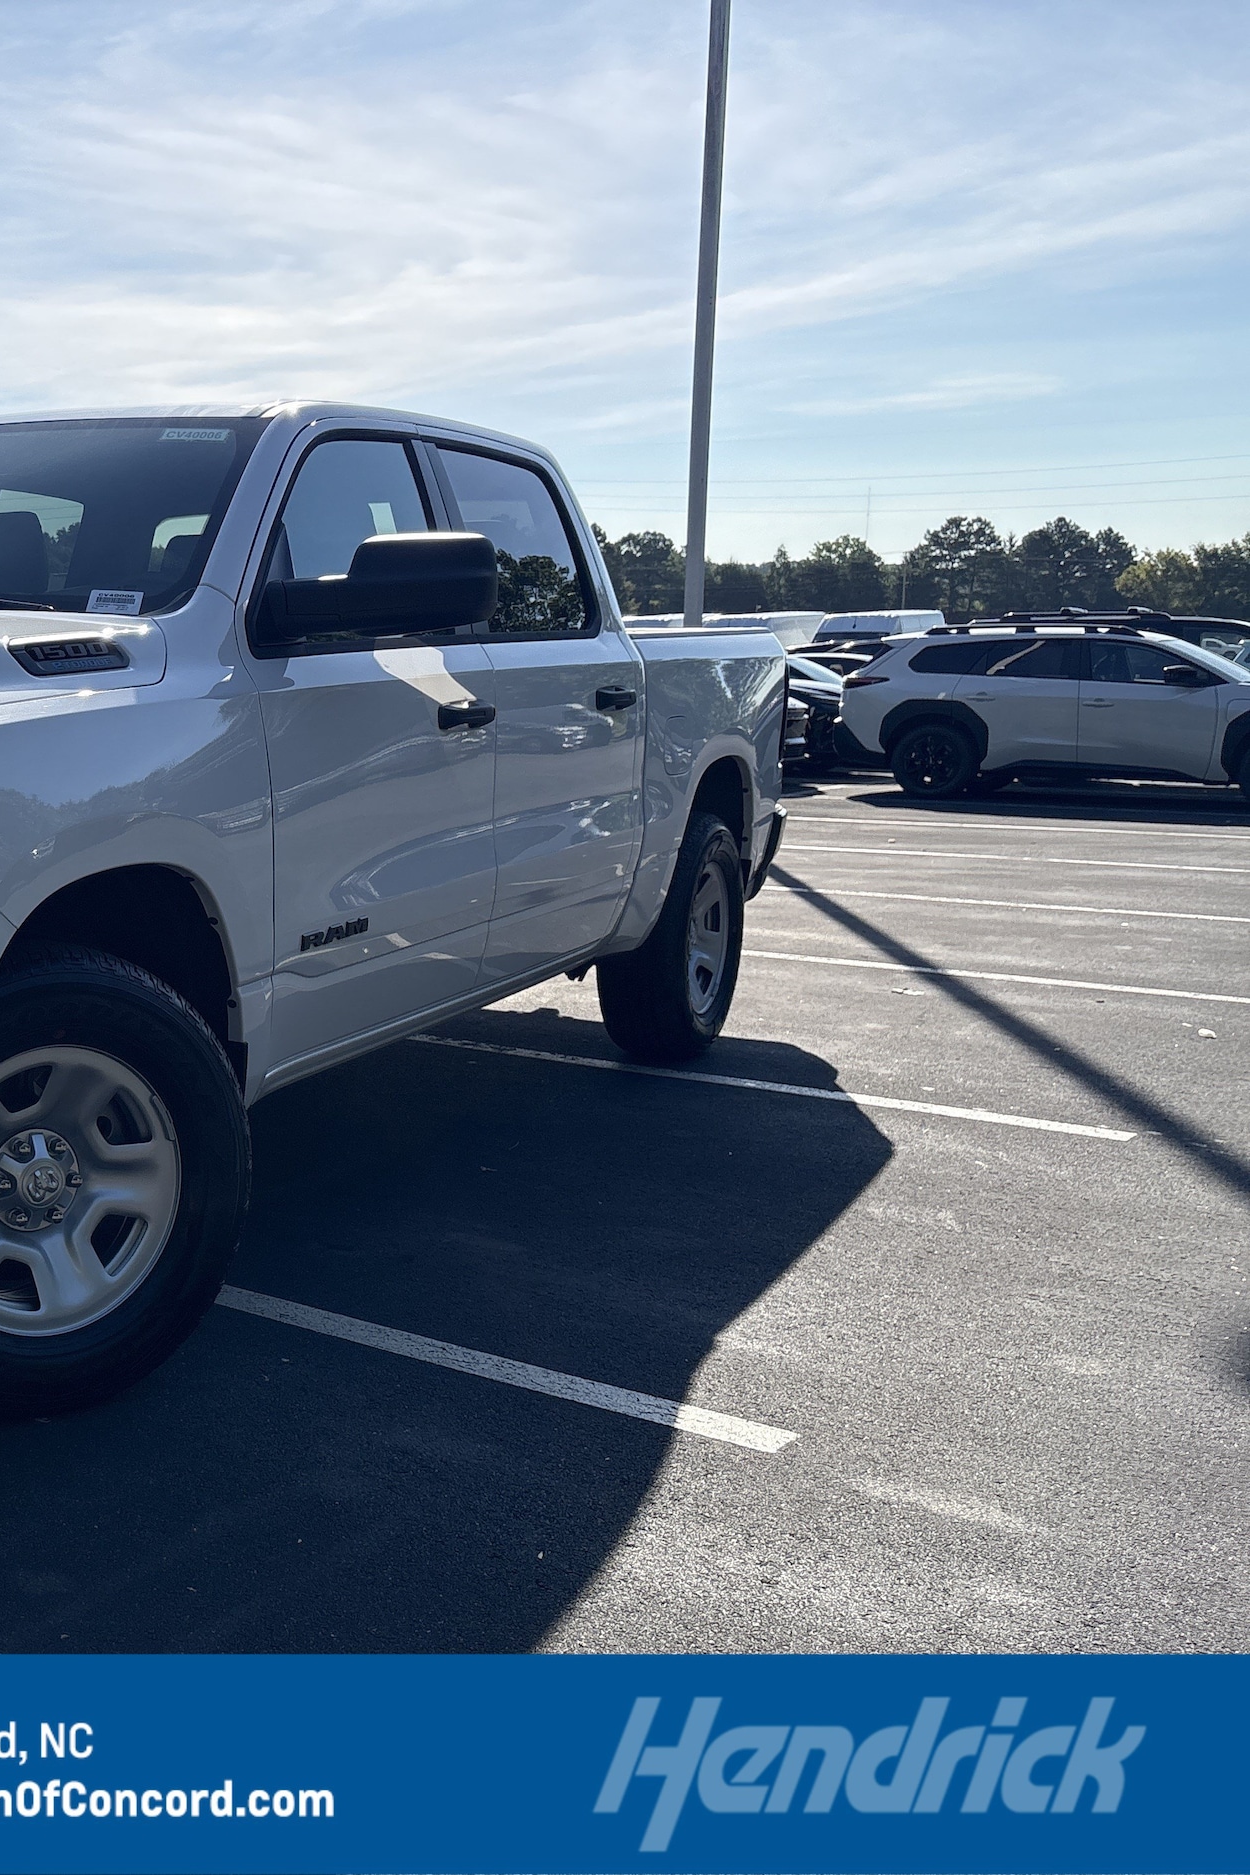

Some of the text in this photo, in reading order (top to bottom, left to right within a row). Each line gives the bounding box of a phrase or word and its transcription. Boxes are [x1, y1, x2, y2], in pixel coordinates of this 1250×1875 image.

[166, 431, 223, 439] CV40006
[31, 642, 109, 660] 1500
[300, 915, 369, 952] RAM
